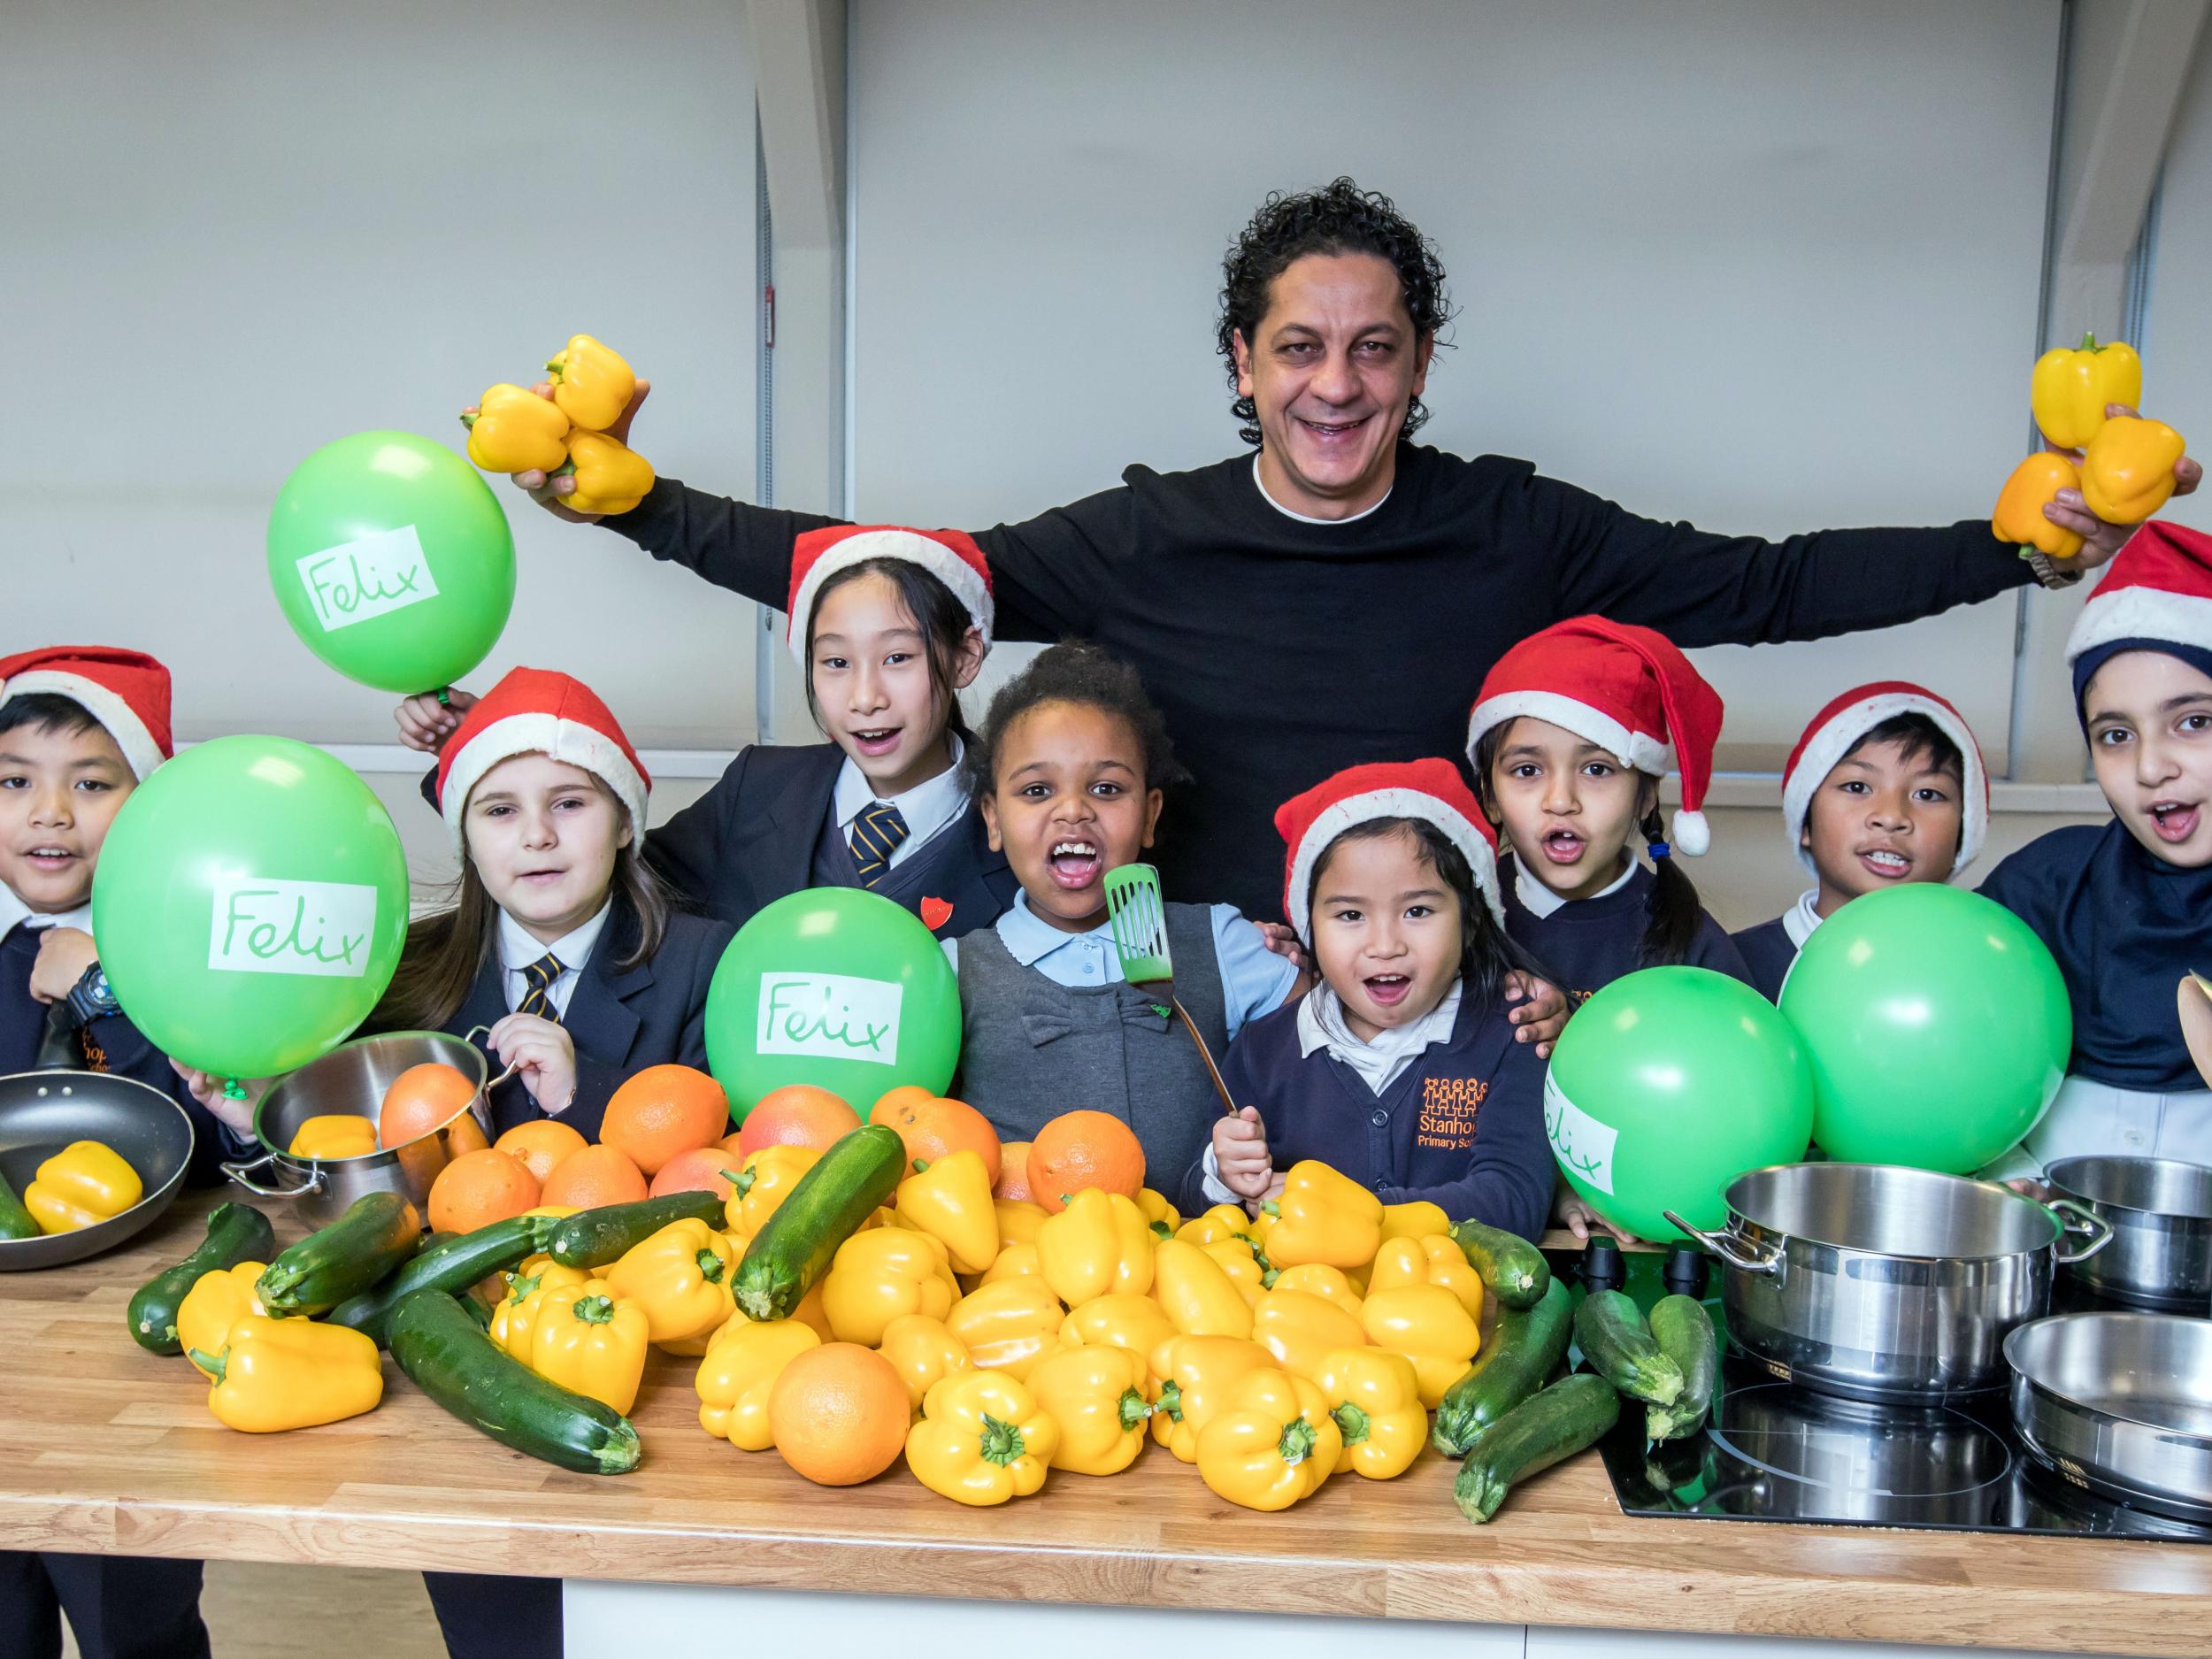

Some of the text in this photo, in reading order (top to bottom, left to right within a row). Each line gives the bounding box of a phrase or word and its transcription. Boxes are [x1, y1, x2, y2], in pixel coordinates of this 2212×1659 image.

[309, 553, 419, 620] Felix
[222, 889, 365, 966] Felix
[765, 981, 890, 1052] Felix
[1417, 1134, 1456, 1150] Primary
